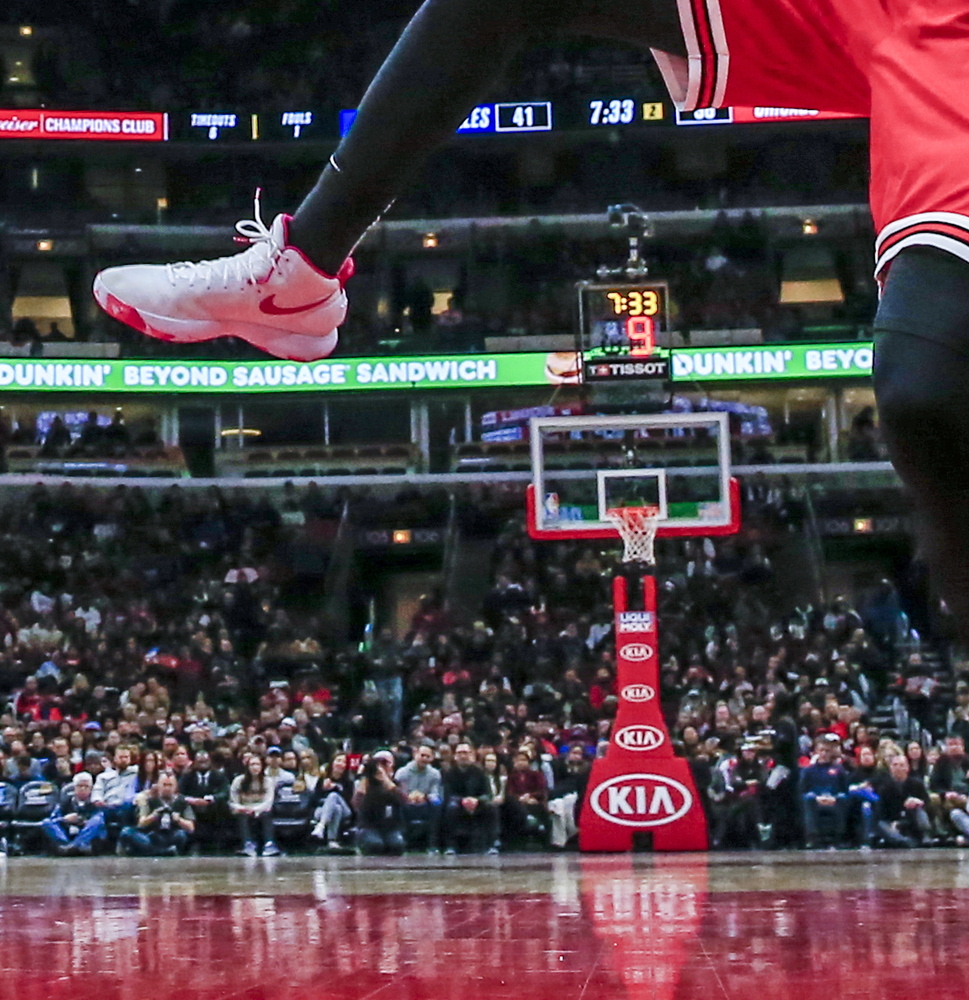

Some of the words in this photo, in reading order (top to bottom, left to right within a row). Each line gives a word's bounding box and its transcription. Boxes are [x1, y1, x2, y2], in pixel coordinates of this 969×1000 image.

[282, 111, 312, 126] FOULS
[512, 106, 534, 127] 41
[589, 99, 634, 125] 7:33
[45, 117, 121, 133] CHAMPIONS
[122, 119, 155, 134] CLUB
[607, 291, 658, 316] 7:33
[626, 315, 654, 357] 9
[609, 363, 666, 376] TISSOT
[672, 350, 792, 376] DUNKIN'
[805, 348, 873, 371] BEYO
[0, 363, 112, 386] DUNKIN'
[123, 365, 228, 387] BEYOND
[232, 364, 347, 387] SAUSAGE
[356, 360, 496, 384] SANDWICH
[625, 646, 648, 658] KIA
[626, 687, 650, 698] KIA
[623, 731, 657, 746] KIA
[608, 786, 676, 815] KIA
